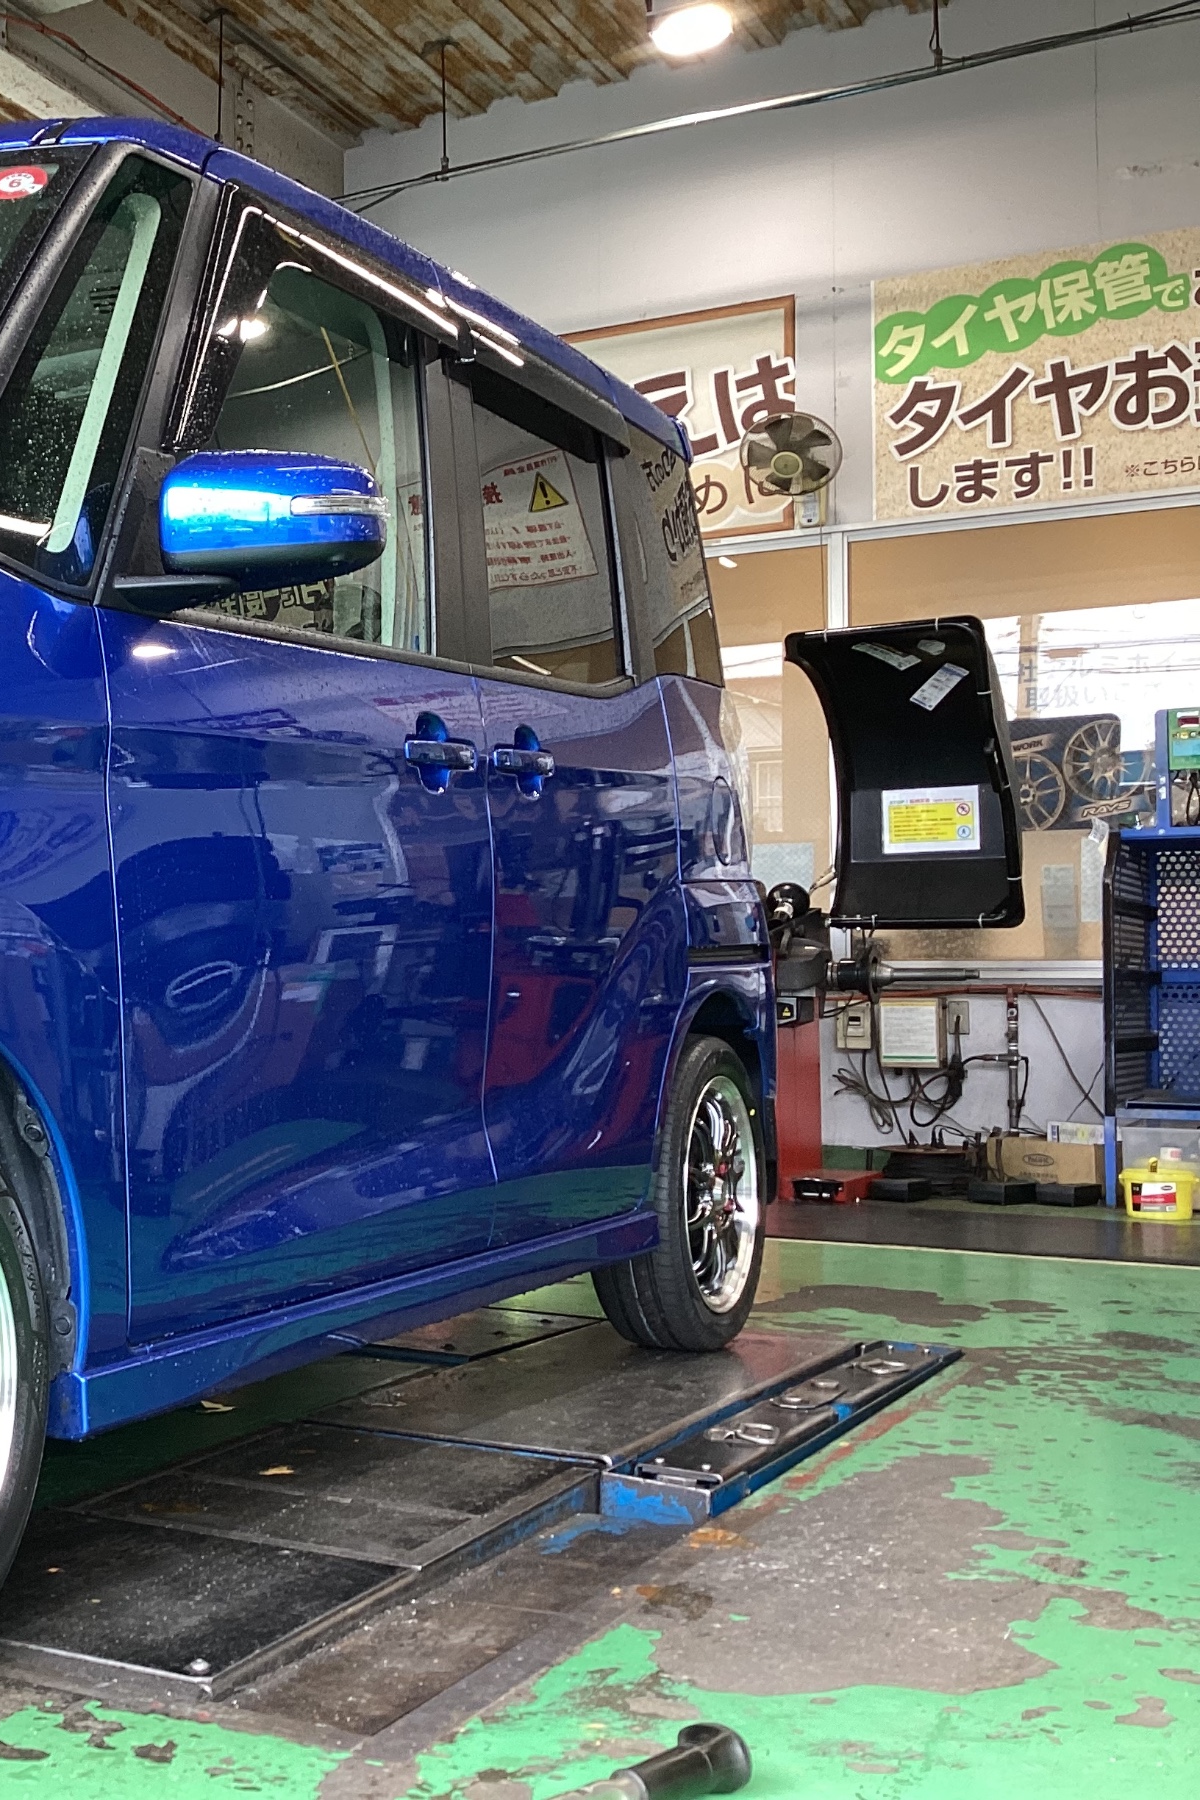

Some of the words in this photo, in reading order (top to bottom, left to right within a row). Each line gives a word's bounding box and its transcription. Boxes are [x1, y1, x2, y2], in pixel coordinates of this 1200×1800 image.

[878, 251, 1200, 378] タイヤ保管で
[889, 342, 1200, 457] タイヤお
[909, 446, 1094, 509] します!!
[1125, 455, 1200, 479] ※こちら
[1012, 738, 1044, 752] WORK
[1080, 799, 1131, 819] RAYS
